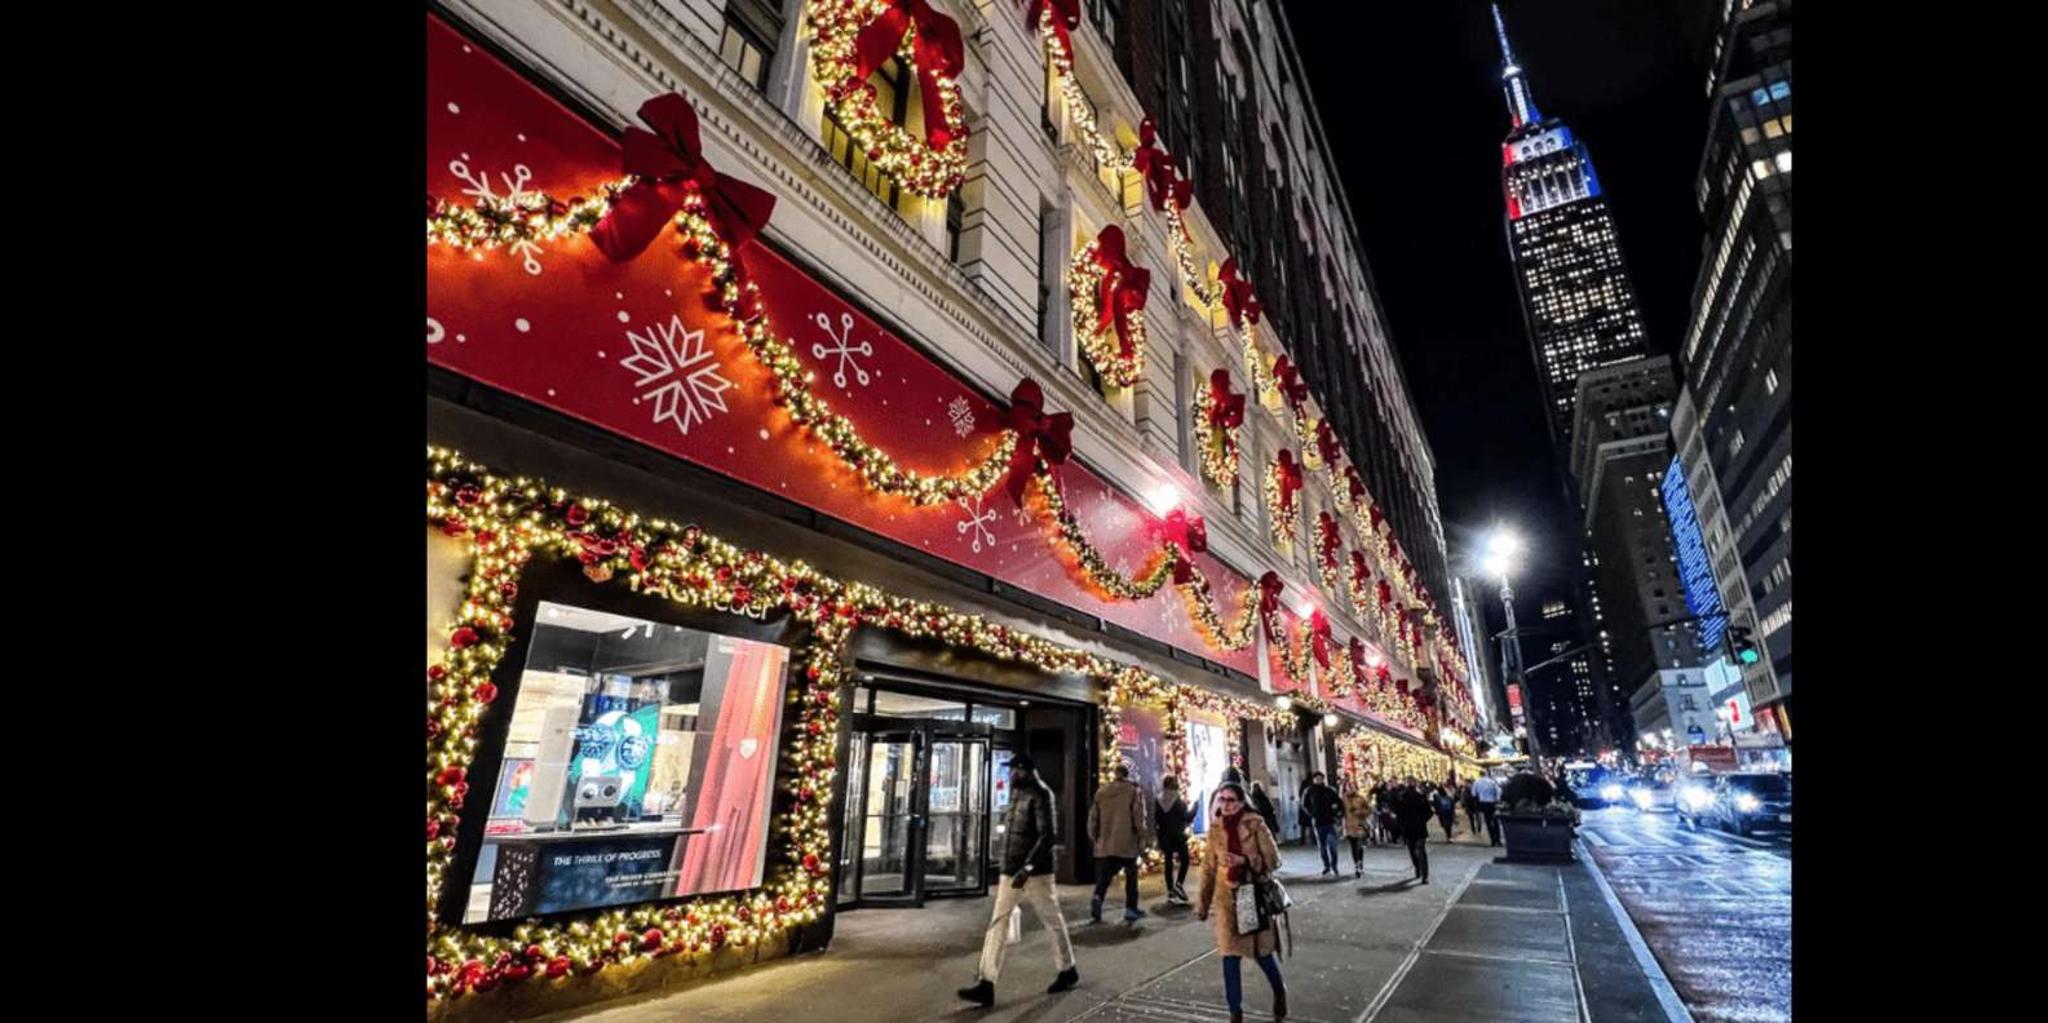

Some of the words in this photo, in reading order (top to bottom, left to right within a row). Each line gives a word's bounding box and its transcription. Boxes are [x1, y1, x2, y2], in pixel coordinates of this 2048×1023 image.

[553, 856, 572, 866] THE
[574, 854, 602, 865] THRILL
[604, 853, 617, 863] OF
[618, 850, 661, 861] PROGRESS
